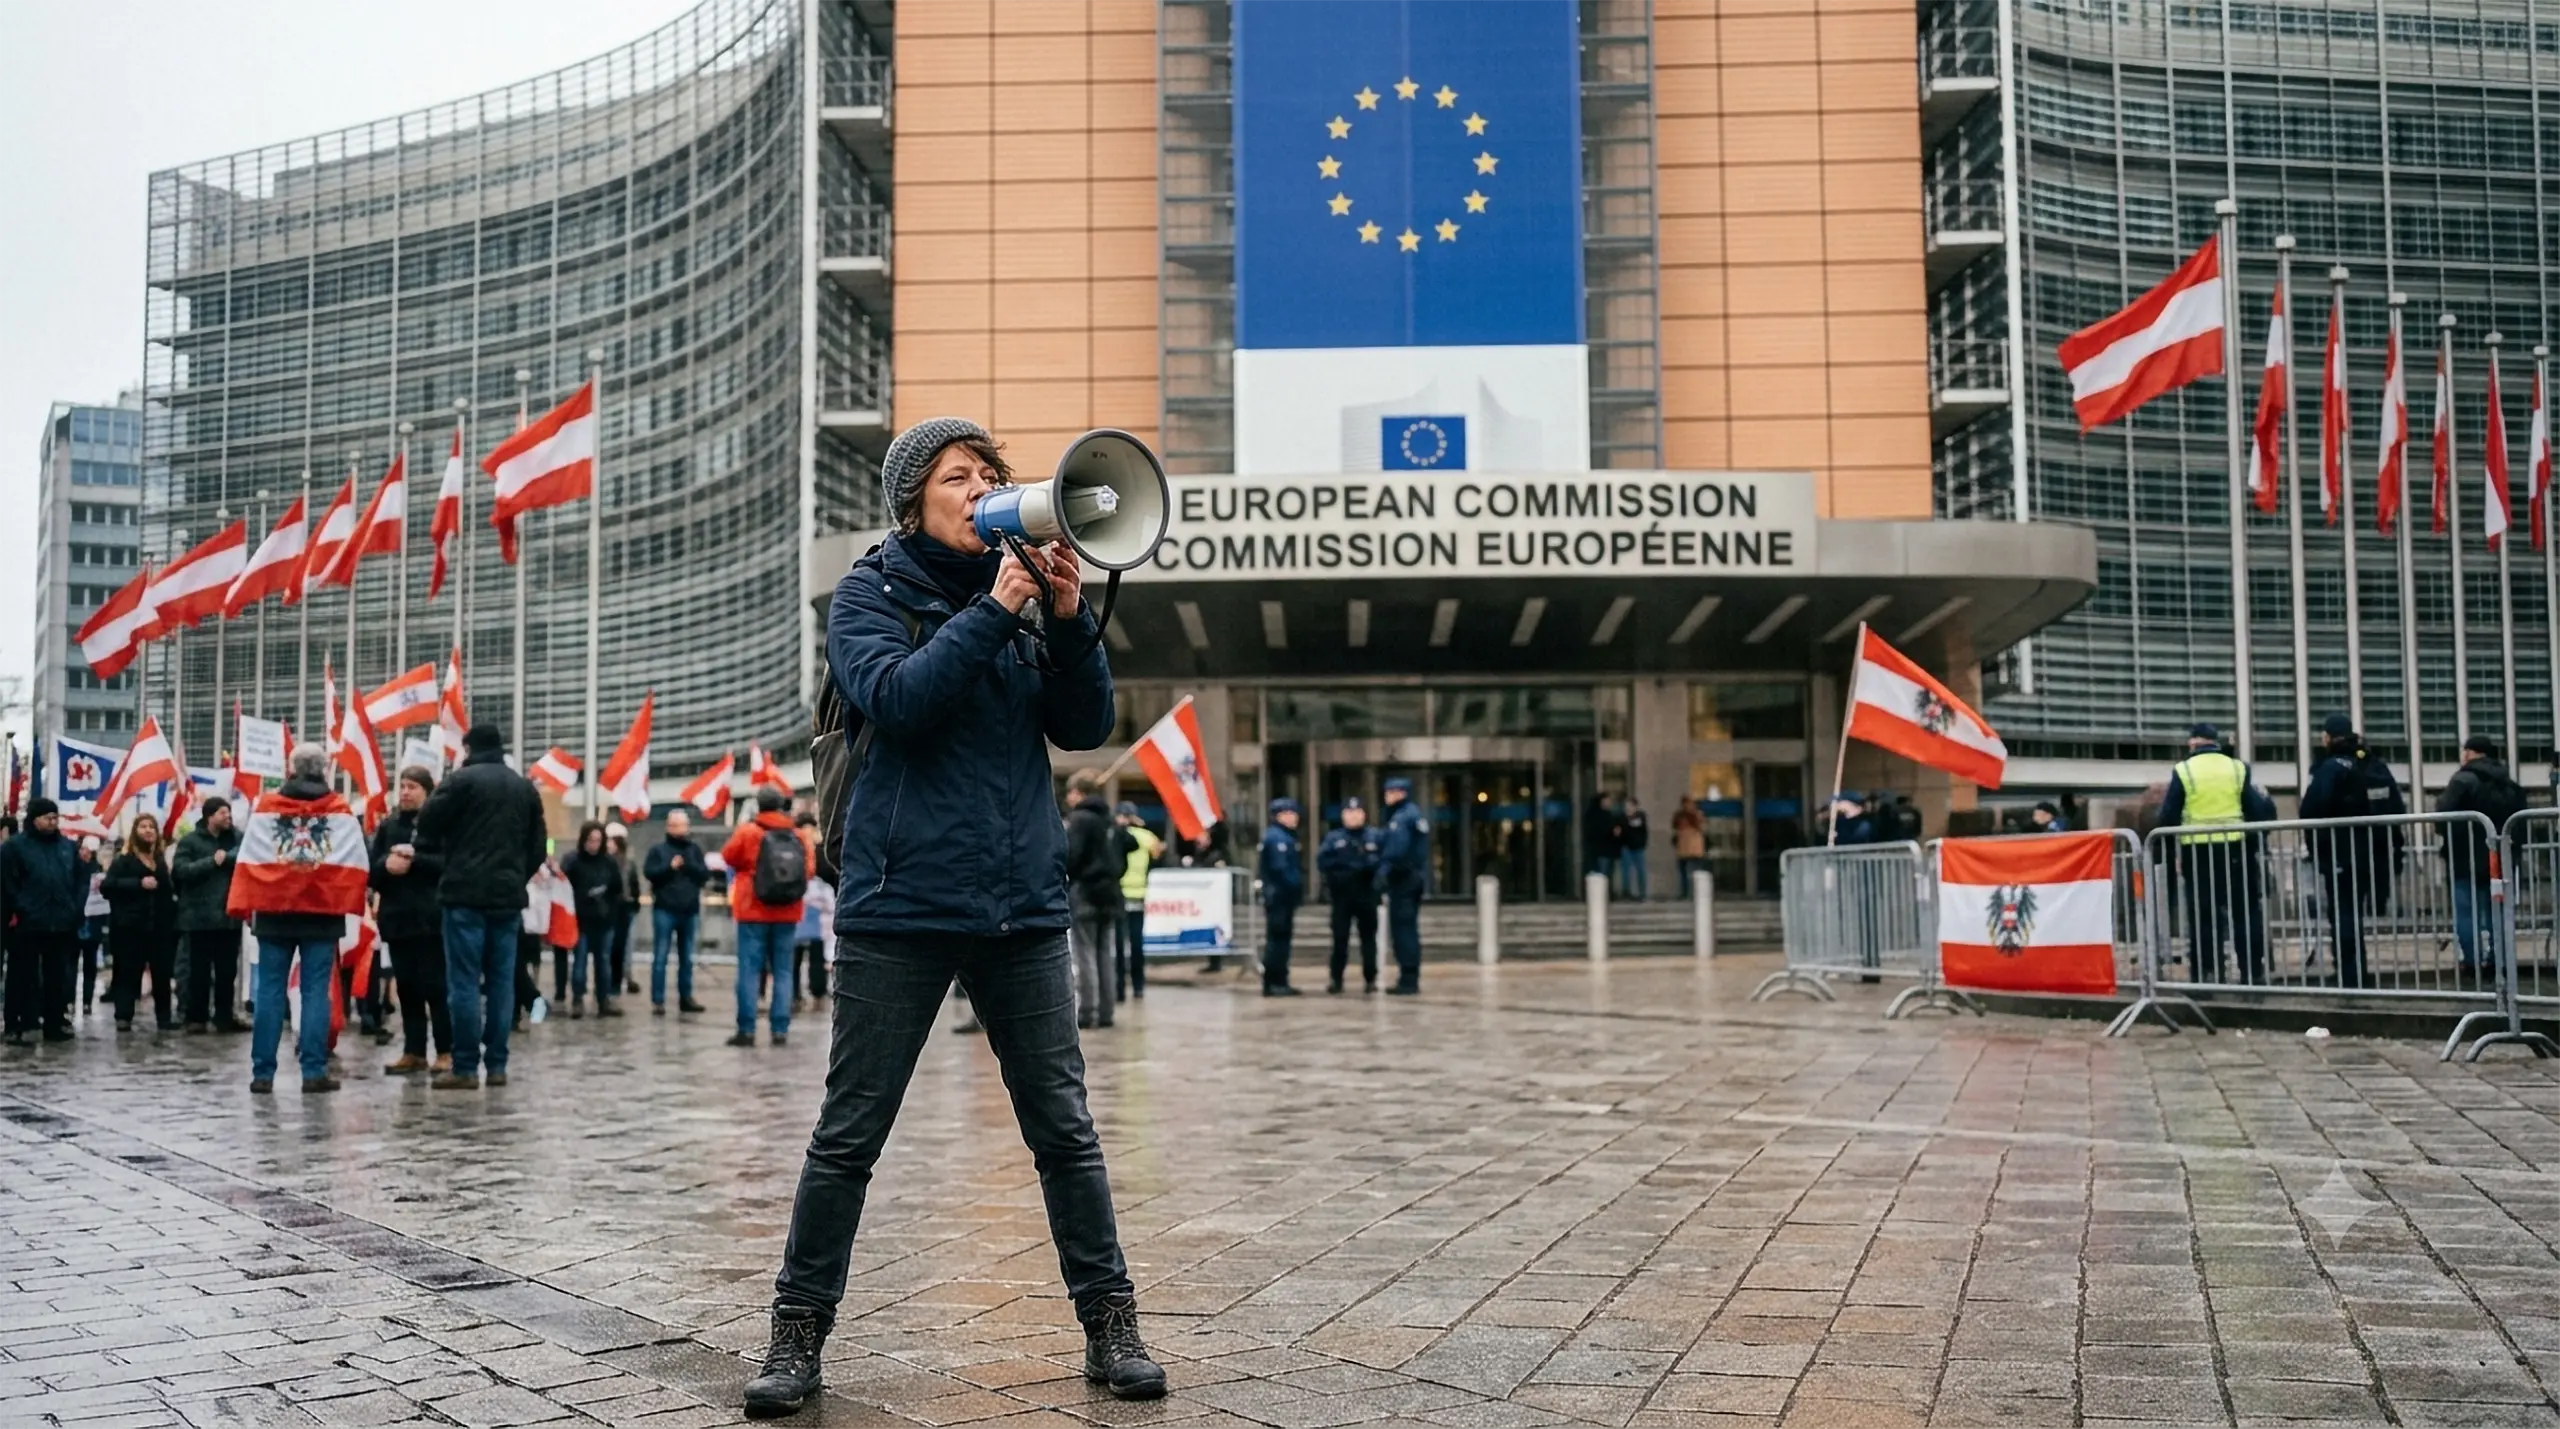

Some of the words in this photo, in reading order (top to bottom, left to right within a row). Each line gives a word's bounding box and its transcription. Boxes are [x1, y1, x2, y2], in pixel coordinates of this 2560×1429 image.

[1181, 485, 1435, 521] EUROPEAN
[1455, 484, 1756, 518] COMMISSION
[1154, 532, 1457, 570] COMMISSION
[1478, 522, 1793, 566] EUROPÉENNE
